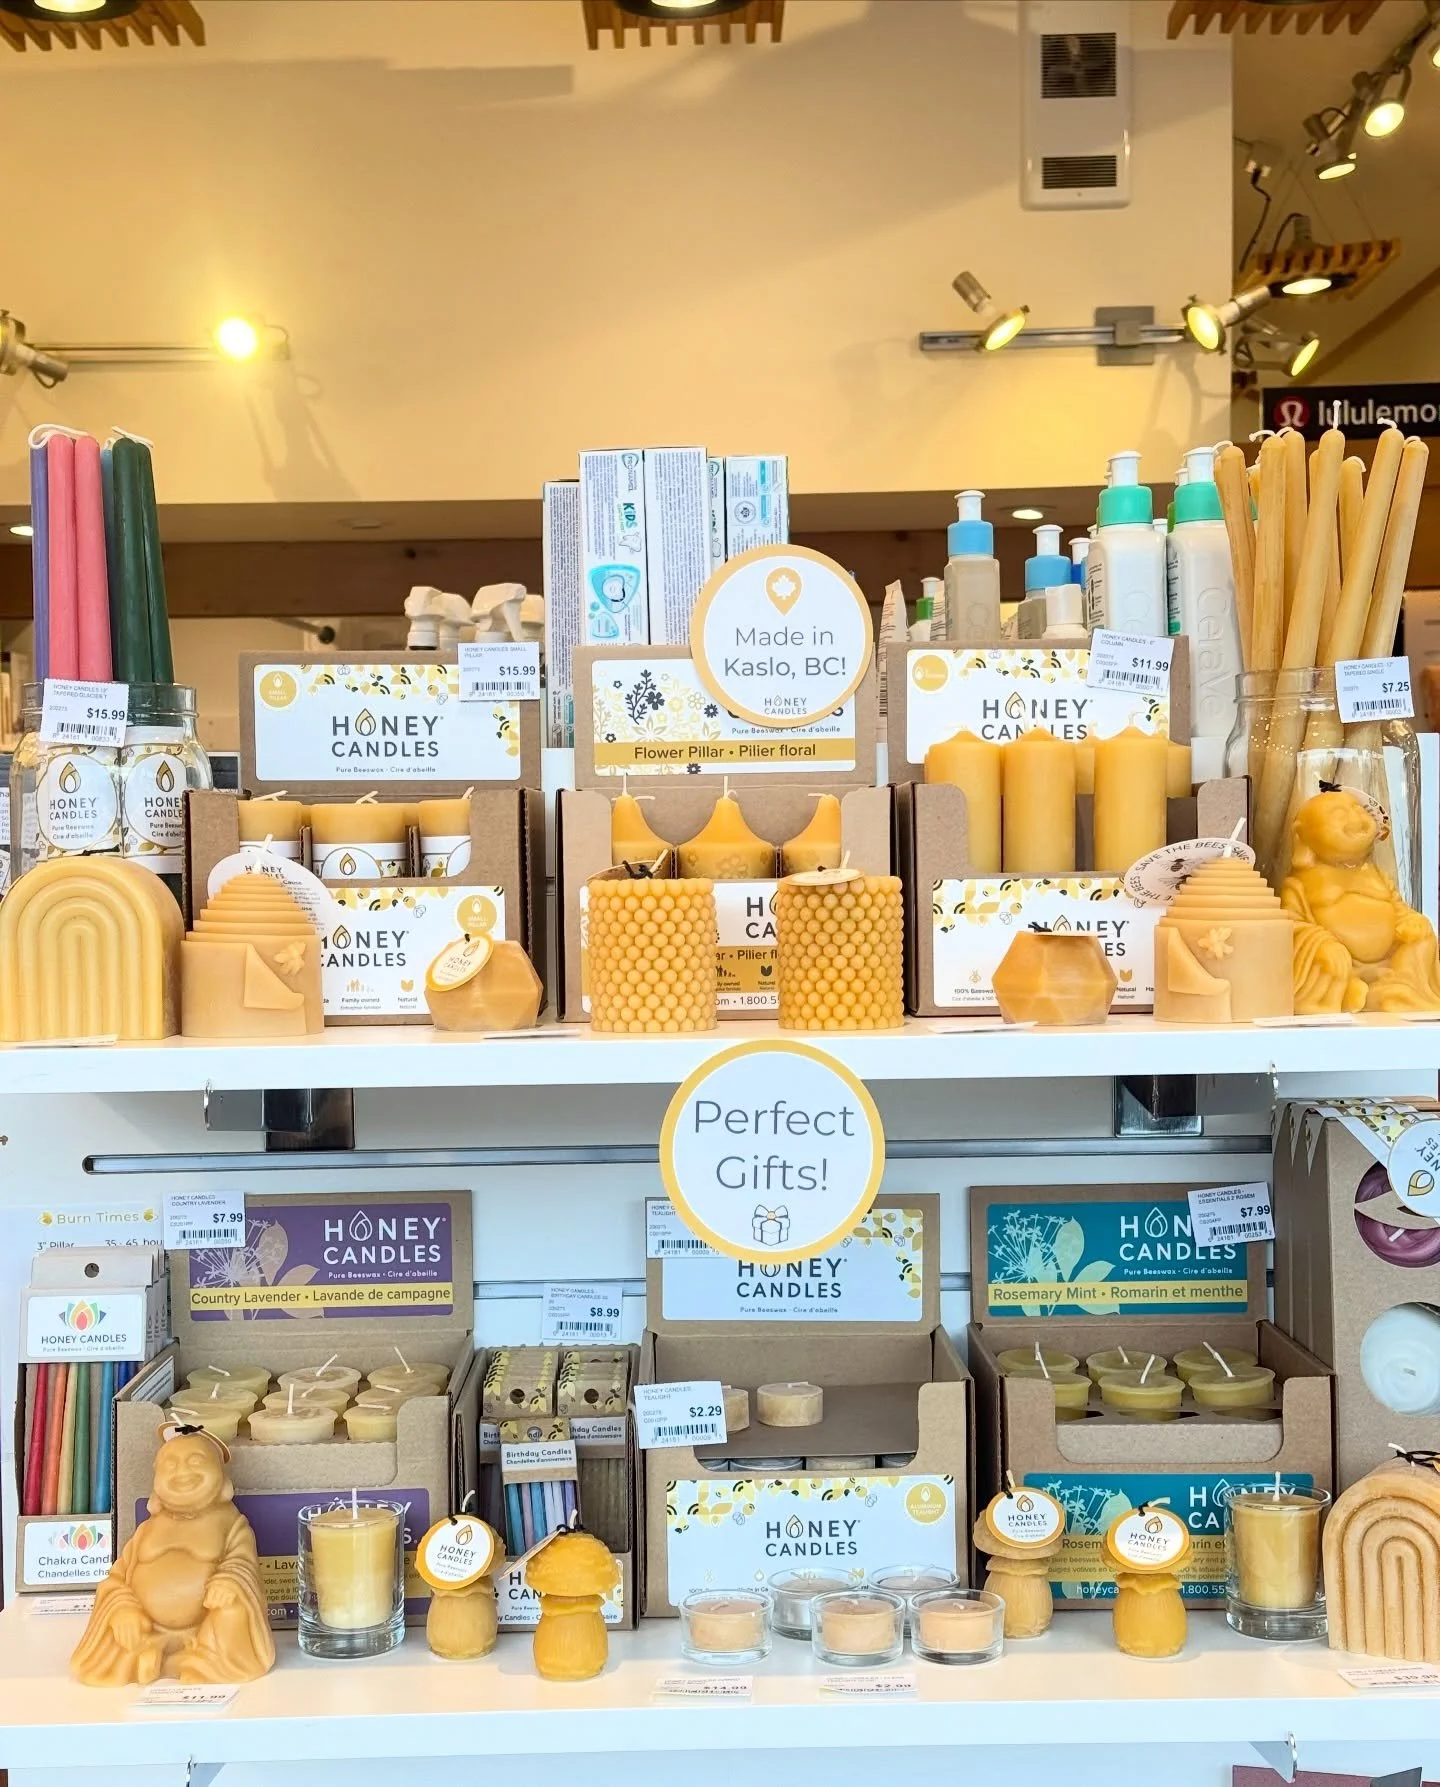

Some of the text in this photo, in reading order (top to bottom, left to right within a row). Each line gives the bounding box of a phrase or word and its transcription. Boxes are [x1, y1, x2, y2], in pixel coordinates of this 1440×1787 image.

[1318, 399, 1440, 427] lululemo
[736, 625, 834, 646] Made in
[499, 665, 536, 677] $15.99
[724, 656, 847, 680] Kaslo, BC!
[1131, 657, 1169, 672] $11.99
[1382, 681, 1410, 693] $7.25
[764, 695, 807, 706] HONEY
[982, 691, 1088, 720] HONEY
[87, 707, 126, 721] $15.99
[764, 706, 808, 715] CANDLES
[332, 708, 439, 737] HONEY
[331, 741, 440, 758] CANDLES
[634, 743, 816, 760] Flower Pillar Pilier floral
[49, 797, 97, 810] HONEY
[144, 797, 182, 808] HONE
[49, 810, 98, 821] CANDLES
[144, 809, 183, 818] CANDLE
[1164, 843, 1191, 854] THE
[245, 865, 282, 874] HNEY
[320, 952, 407, 967] ANDLES
[737, 949, 767, 960] Pilier
[694, 1099, 855, 1137] Perfect
[715, 1154, 828, 1191] Gifts!
[57, 1211, 140, 1225] Burn Times
[1240, 1205, 1271, 1218] $7.99
[213, 1213, 243, 1224] $7.99
[1120, 1206, 1192, 1238] HON
[324, 1209, 440, 1242] HONEY
[143, 1237, 164, 1247] hou
[323, 1245, 441, 1265] CANDLES
[1119, 1243, 1237, 1262] CANDLES
[328, 1271, 346, 1279] Pure
[387, 1270, 403, 1278] Cire
[1124, 1268, 1141, 1276] Pure
[1200, 1267, 1233, 1275] d'abeille
[736, 1282, 842, 1299] CANDLES
[993, 1284, 1243, 1302] Rosemary Mint Romarin et menthe
[191, 1289, 451, 1306] Country Lavender Lavande de campagne
[590, 1307, 620, 1318] $8.99
[41, 1334, 127, 1345] HONEY CANDLES
[689, 1405, 722, 1418] $2.29
[591, 1425, 622, 1433] Candles
[506, 1448, 572, 1459] Birthday Candles
[1007, 1513, 1046, 1522] HONEY
[1008, 1520, 1048, 1528] CANDLES
[766, 1514, 858, 1539] HONEY
[1062, 1538, 1101, 1549] Rosem
[1130, 1532, 1171, 1546] HONEY
[439, 1544, 477, 1559] HONEY
[765, 1541, 858, 1557] CANDLES
[1127, 1540, 1167, 1552] CANDLES
[38, 1554, 112, 1566] Chakra Cand
[436, 1552, 473, 1566] CANDLES
[37, 1568, 110, 1578] Chandelles cha
[504, 1614, 531, 1622] Candles
